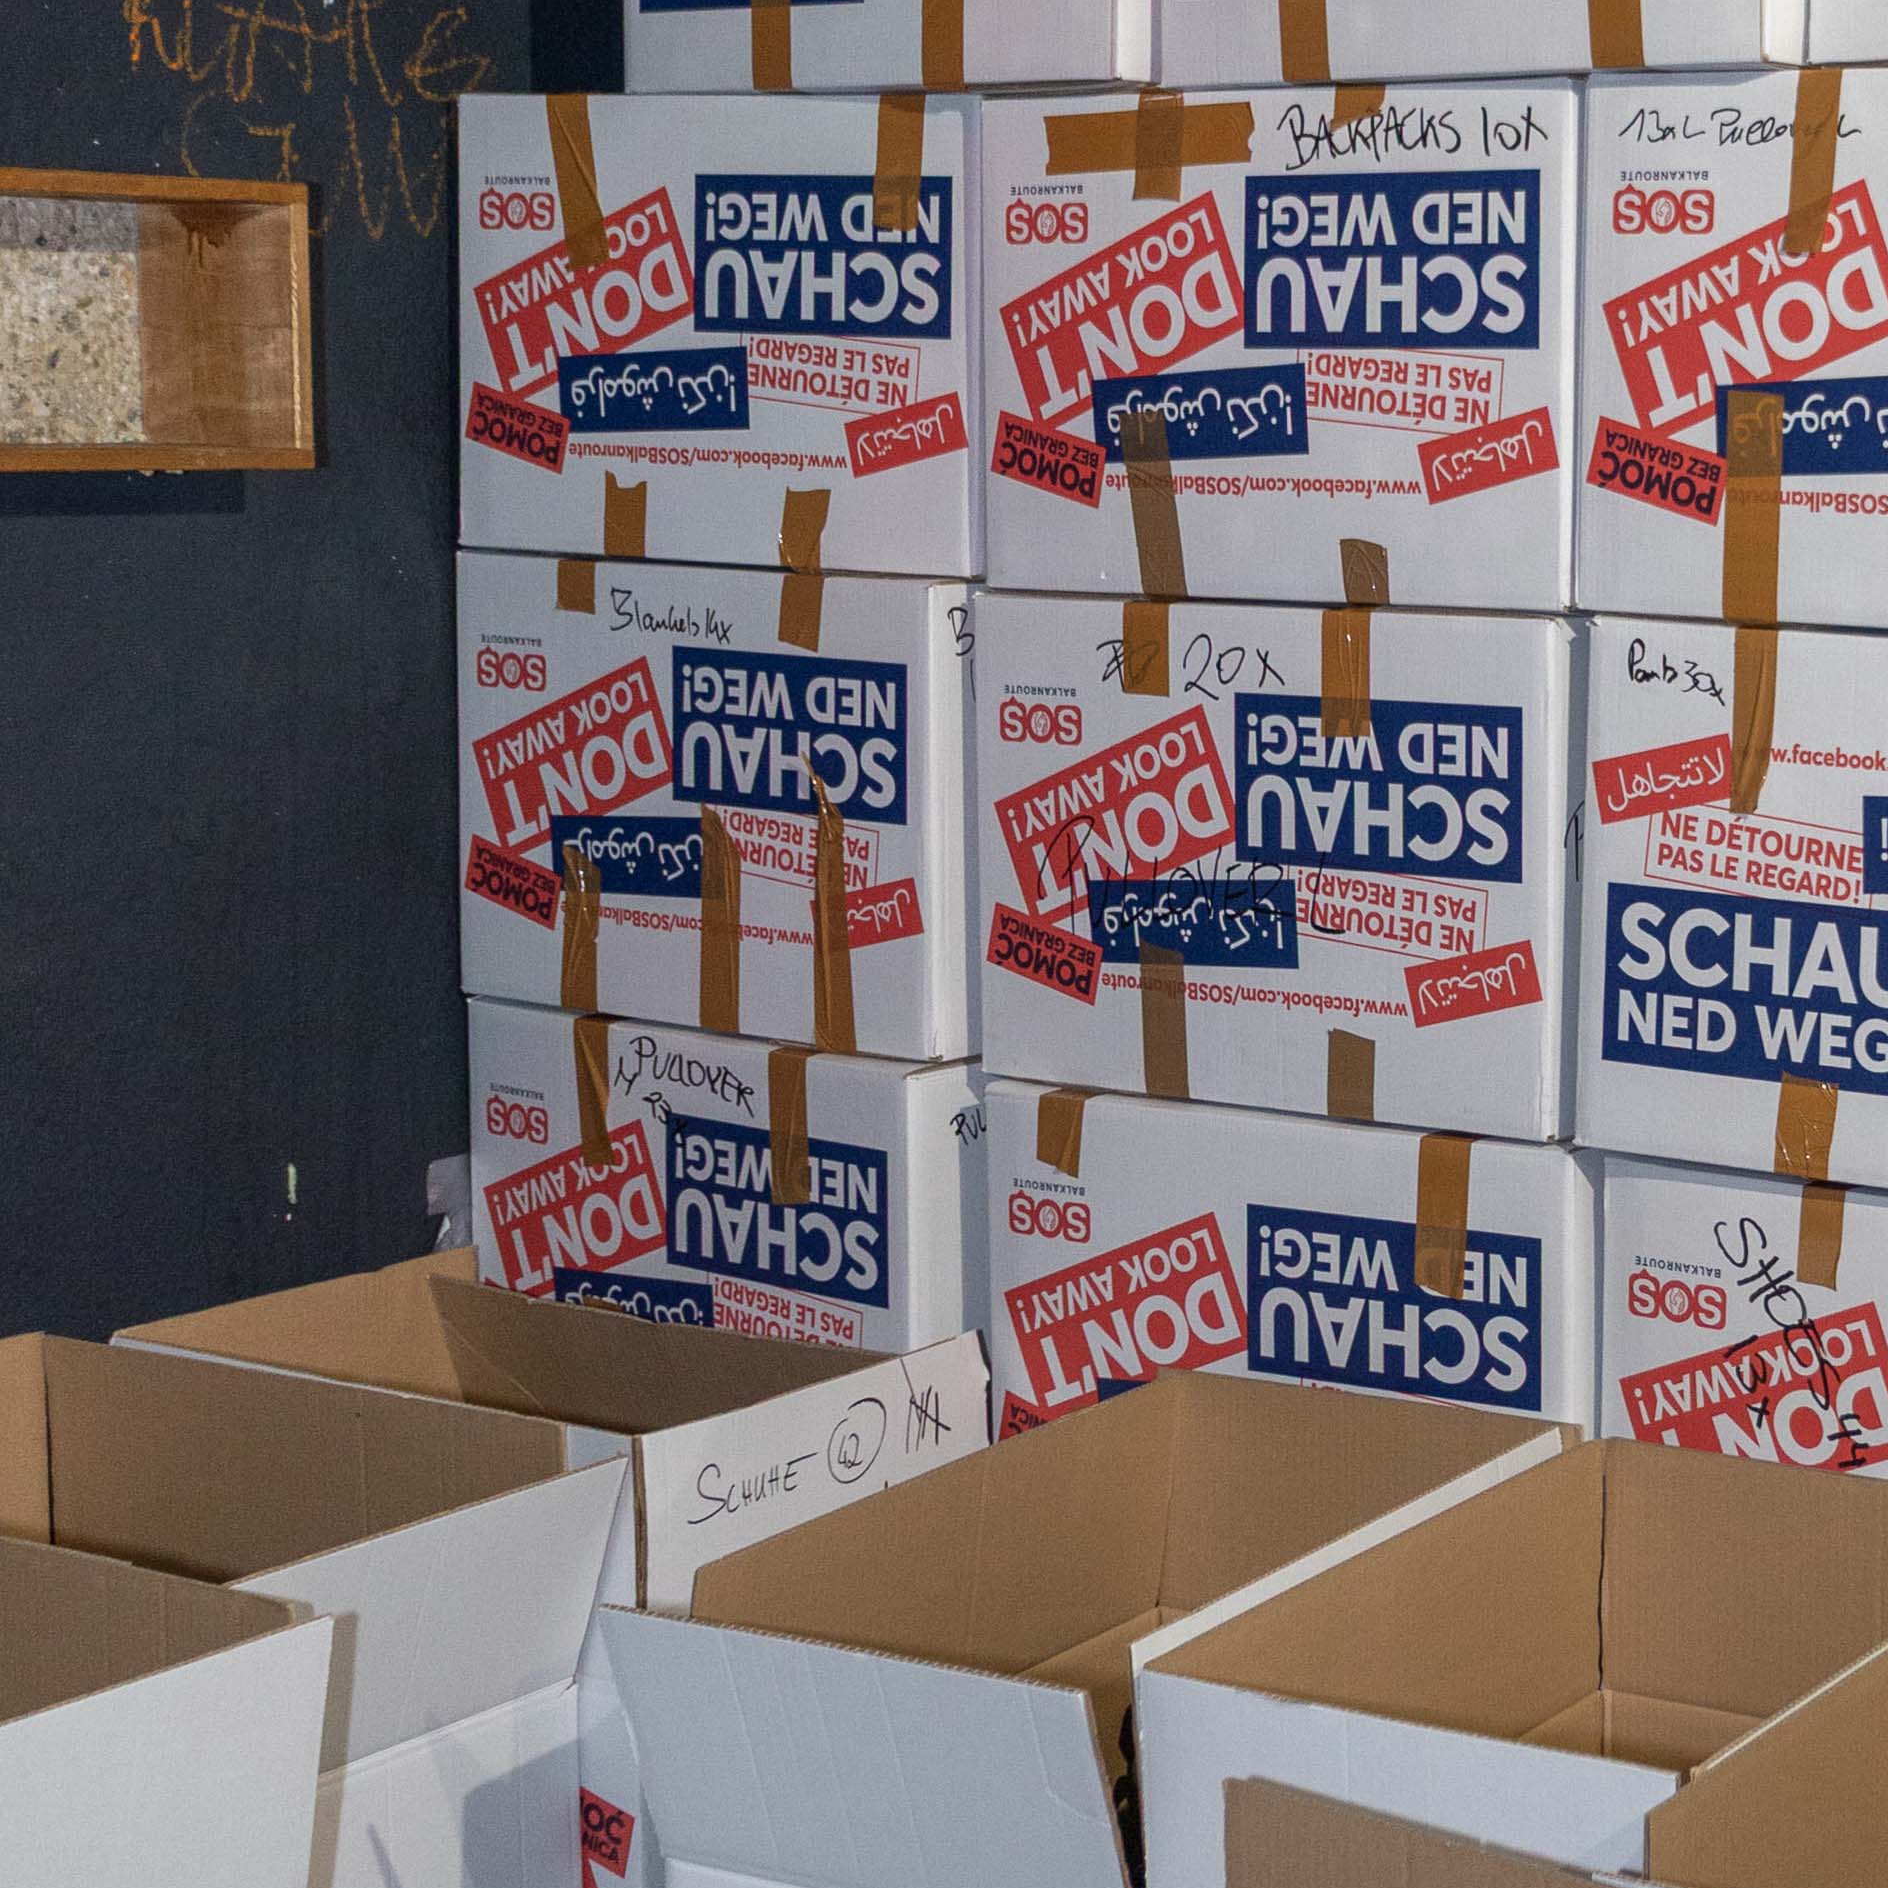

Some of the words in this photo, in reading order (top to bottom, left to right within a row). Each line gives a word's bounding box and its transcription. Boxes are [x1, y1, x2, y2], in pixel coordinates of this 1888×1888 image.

[483, 191, 551, 227] SOS
[1258, 193, 1396, 248] WEG!
[1413, 191, 1525, 245] NED
[1115, 207, 1214, 285] LOOK
[704, 246, 941, 325] SCHAU
[1011, 261, 1111, 347] AWAY!
[1255, 255, 1527, 333] SCHAU
[568, 670, 648, 733] LOOK
[683, 666, 793, 720] WEG!
[806, 674, 896, 731] NED
[483, 710, 565, 779] AWAY!
[1246, 770, 1510, 868] SCHAU
[995, 932, 1092, 996] POMOĆ
[1616, 987, 1737, 1056] NED
[674, 1182, 879, 1294] SCHAU
[1011, 1195, 1086, 1241] SOS
[1634, 1255, 1721, 1279] BALKANROUTE
[1632, 1274, 1721, 1327] SOS
[1258, 1281, 1528, 1396] SCHAU
